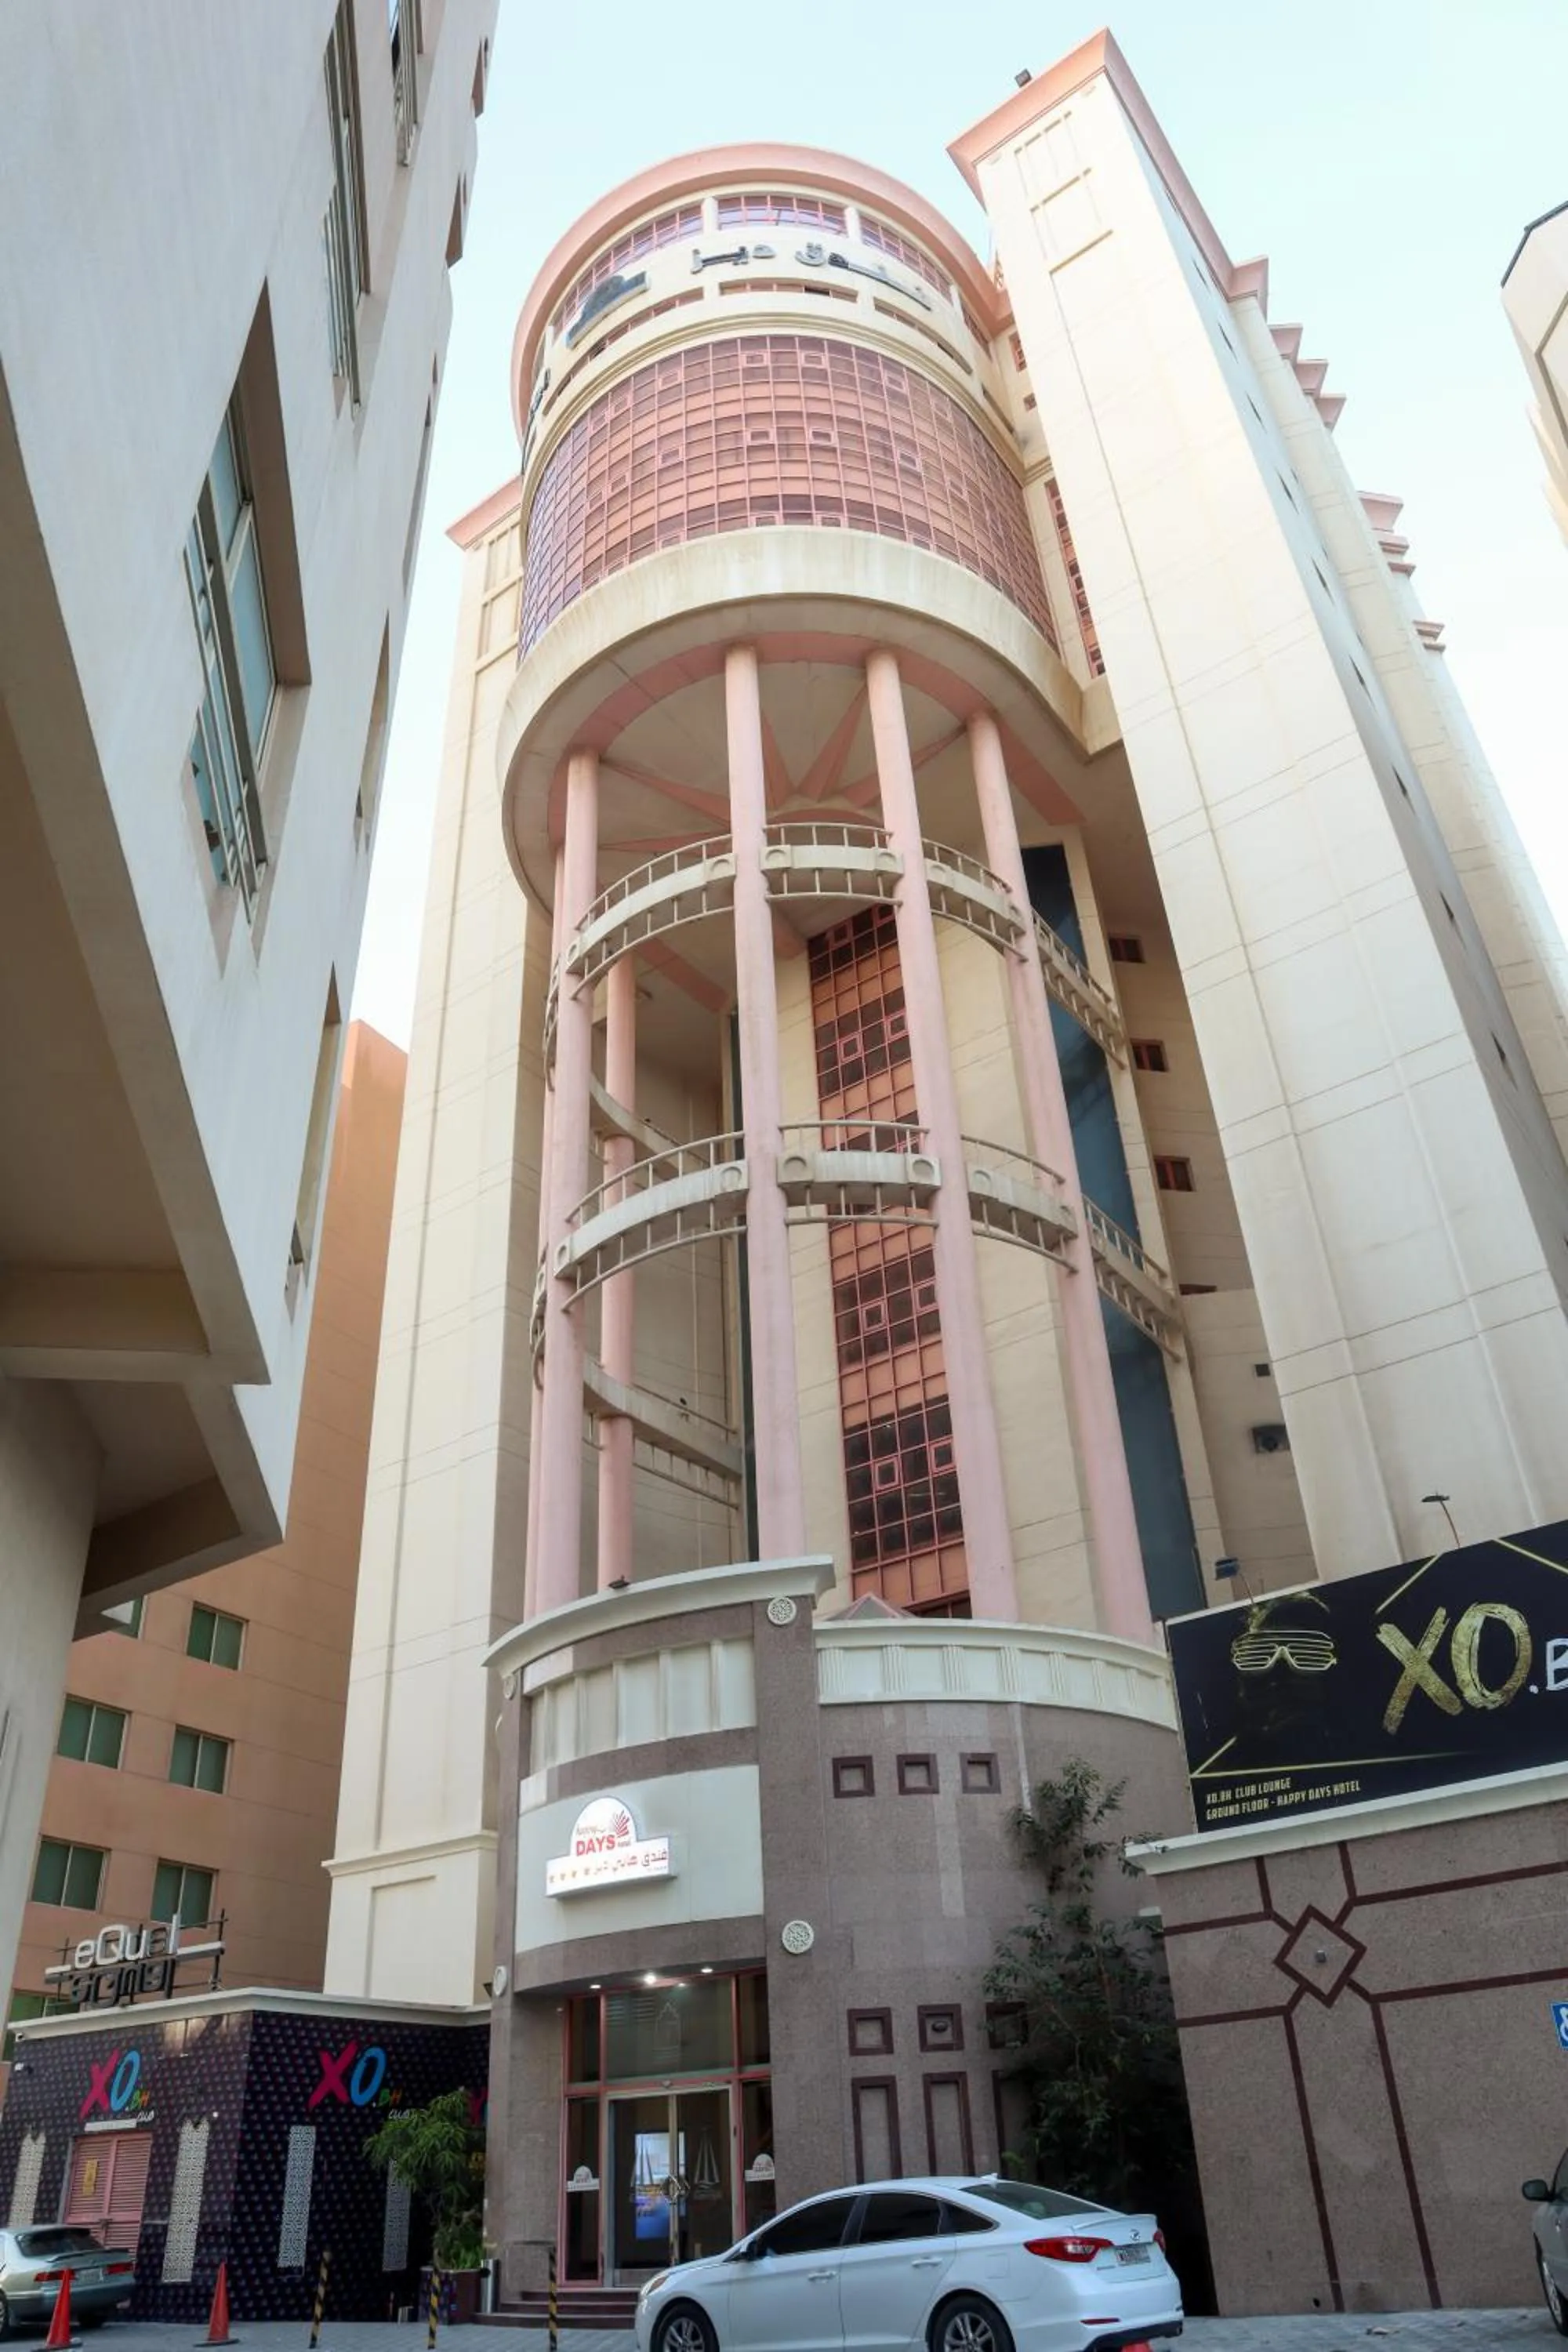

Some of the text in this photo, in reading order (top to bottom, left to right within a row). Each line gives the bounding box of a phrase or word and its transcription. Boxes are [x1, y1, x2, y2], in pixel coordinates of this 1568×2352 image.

[1206, 1802, 1240, 1820] GROUND
[1241, 1797, 1269, 1813] FLOOR
[1276, 1791, 1307, 1807] HAPPY
[1308, 1786, 1331, 1800] DAYS
[1333, 1780, 1361, 1795] HOTEL
[1235, 1783, 1255, 1798] CLUB
[1258, 1777, 1291, 1794] LOUNGE
[575, 1835, 615, 1857] DAYS
[74, 1914, 180, 1969] eQual
